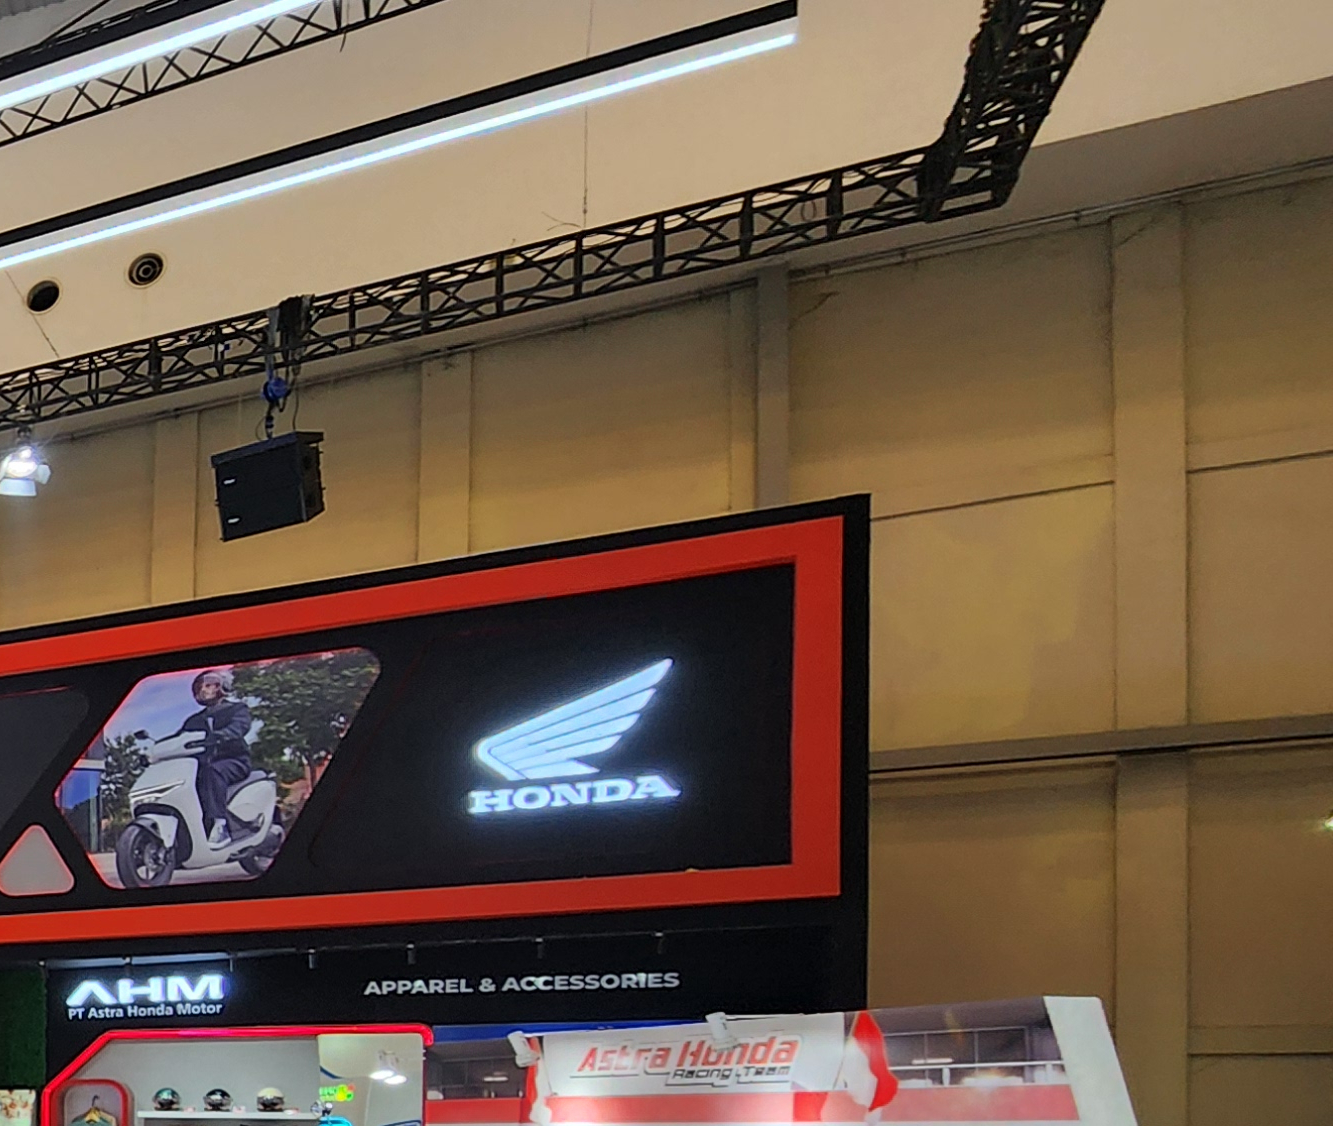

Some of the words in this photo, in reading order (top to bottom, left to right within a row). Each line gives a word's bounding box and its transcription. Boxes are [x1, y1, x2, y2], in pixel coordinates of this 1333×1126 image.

[466, 774, 682, 814] HONDA
[65, 974, 226, 1006] AHM
[363, 978, 474, 996] APPAREL
[479, 977, 497, 993] &
[501, 972, 681, 992] ACCESSORIES
[68, 1007, 85, 1020] PT
[87, 1006, 124, 1019] Astra
[127, 1004, 174, 1017] Honda
[176, 1003, 223, 1016] Motor
[577, 1044, 672, 1073] Astra
[676, 1036, 799, 1068] Honda
[672, 1067, 733, 1081] Racing
[742, 1065, 791, 1077] Team
